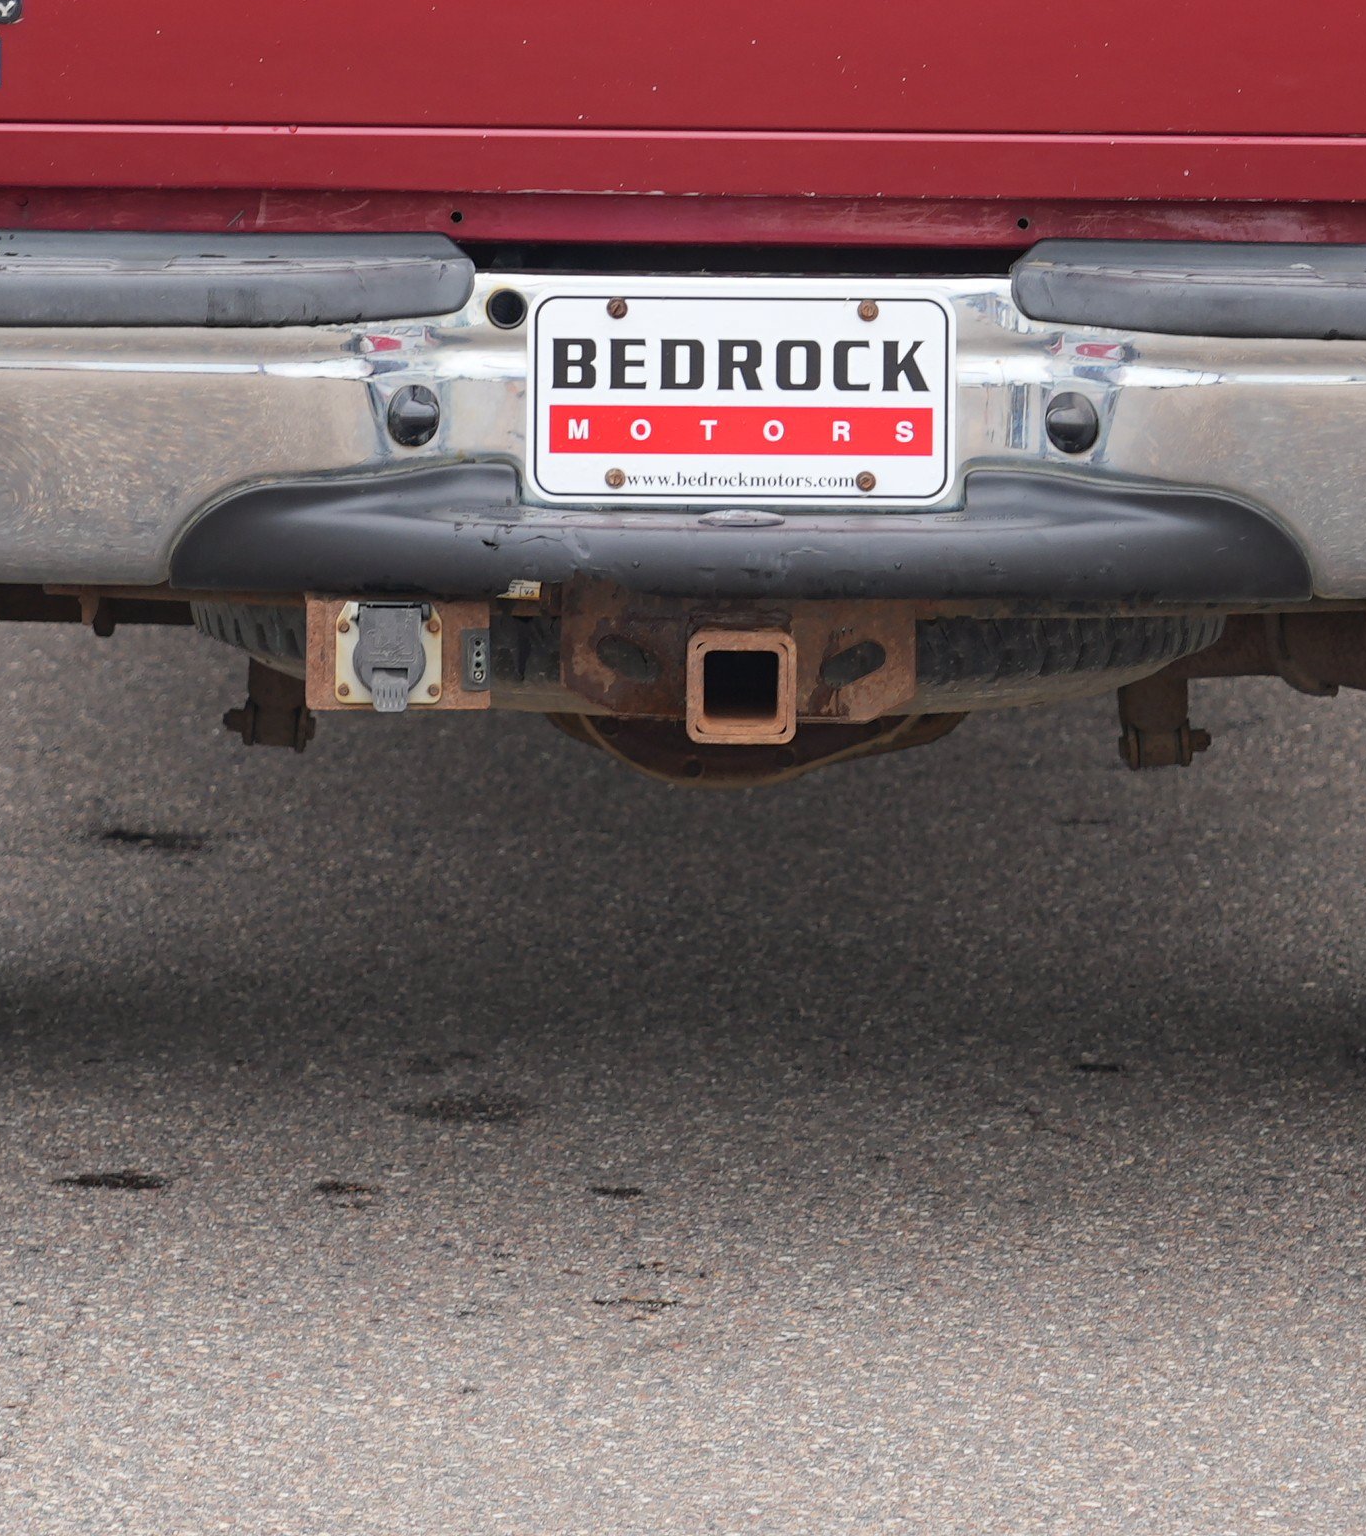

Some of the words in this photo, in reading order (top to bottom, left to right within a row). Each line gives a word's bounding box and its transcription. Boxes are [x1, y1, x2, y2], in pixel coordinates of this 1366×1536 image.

[551, 337, 931, 393] BEDROCK
[567, 418, 915, 444] MOTORS
[626, 470, 856, 490] www.bedrockmotors.com
